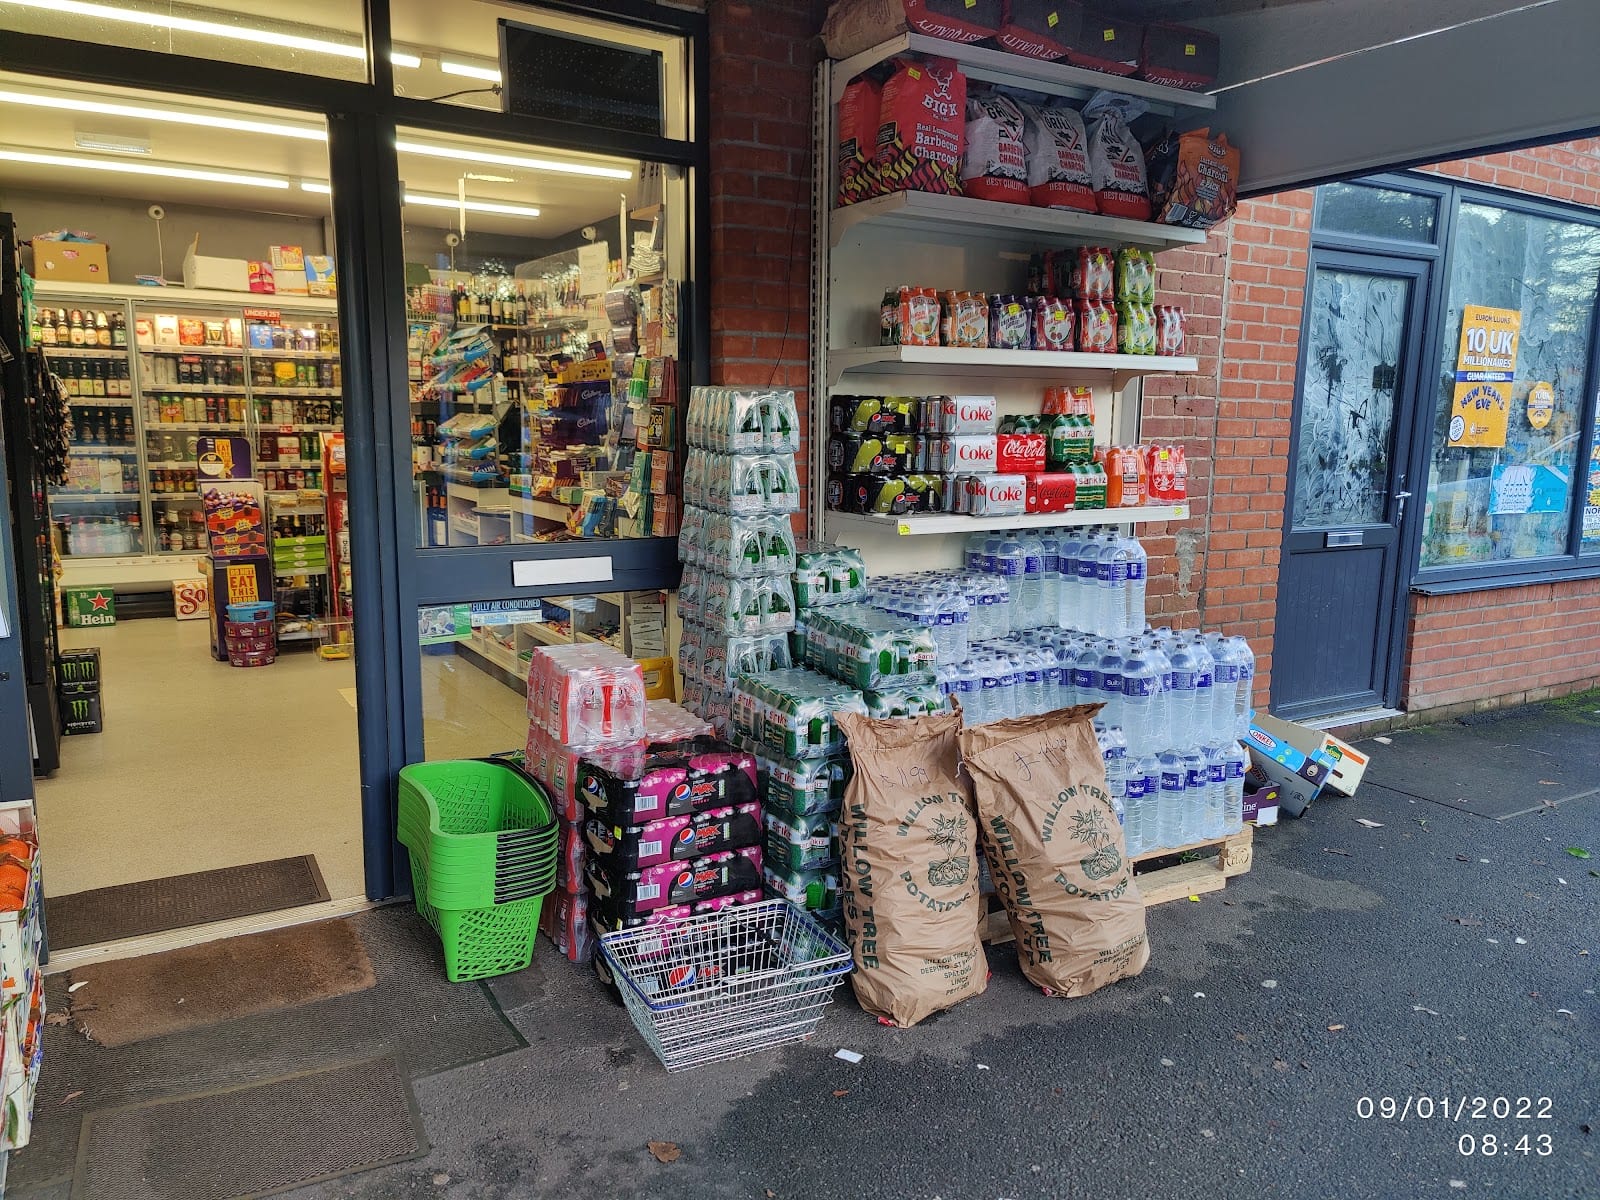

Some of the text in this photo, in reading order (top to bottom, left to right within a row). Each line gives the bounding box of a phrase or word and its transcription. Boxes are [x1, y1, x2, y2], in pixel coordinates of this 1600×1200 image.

[915, 19, 962, 40] QUALITY
[1001, 33, 1044, 54] QUALITY
[917, 123, 931, 131] Real
[915, 132, 958, 153] Barbecue
[914, 146, 959, 166] Charcoal
[1050, 182, 1065, 191] BEST
[1104, 191, 1139, 204] BEST QUALITY
[1467, 328, 1514, 355] 10 UK
[1463, 355, 1512, 369] MILLIONAIRES
[1466, 372, 1506, 381] GUARANTEED
[1460, 386, 1480, 409] NEW
[1475, 398, 1492, 410] EVE
[960, 405, 993, 422] Coke
[959, 444, 993, 461] Coke
[1003, 438, 1046, 458] Coca-Cola
[989, 485, 1022, 502] Coke
[230, 576, 254, 588] EAT
[231, 587, 255, 597] THIS
[472, 599, 541, 612] FULLY AIR CONDITIONED
[691, 780, 717, 796] MAX
[896, 794, 944, 837] WILLOW
[1041, 785, 1078, 842] WILLOW
[695, 823, 721, 839] MAX
[694, 868, 720, 883] MAX
[851, 803, 880, 970] WILLOW TREE
[990, 814, 1052, 963] WILLOW TREE
[1055, 872, 1128, 901] POTATOES
[921, 964, 950, 975] DEEPING
